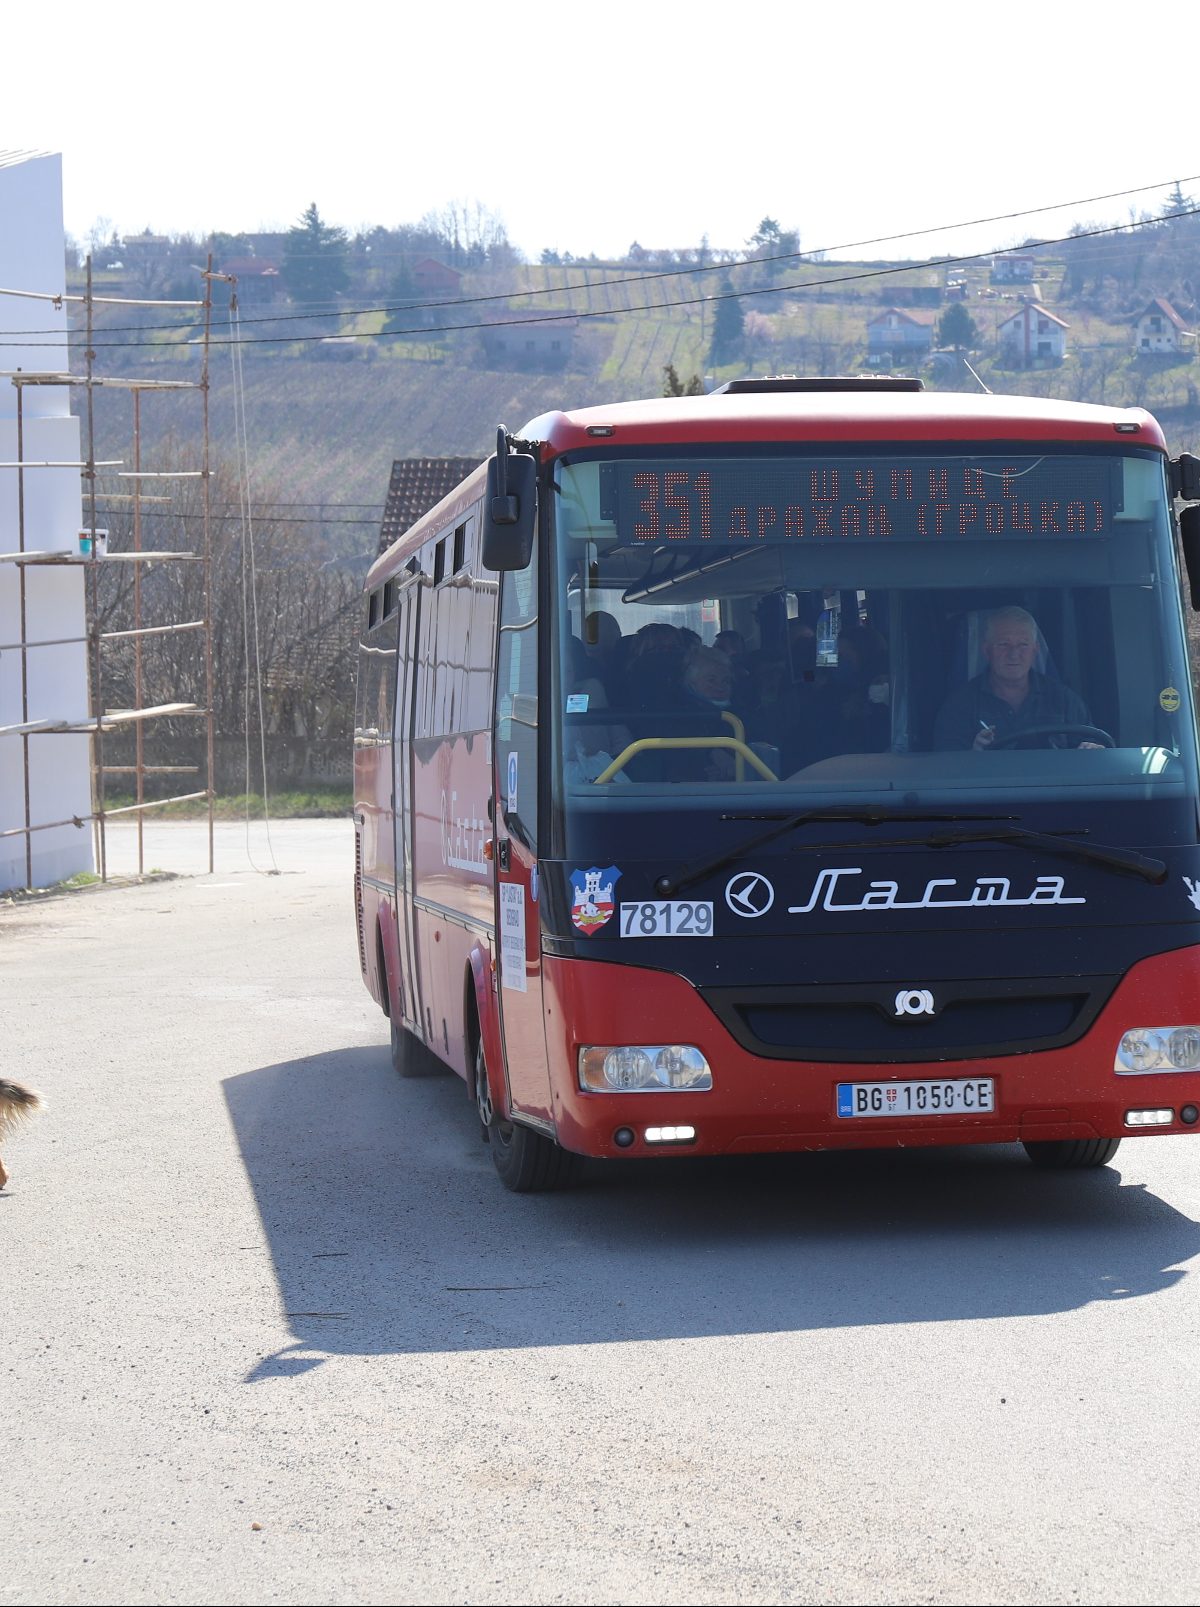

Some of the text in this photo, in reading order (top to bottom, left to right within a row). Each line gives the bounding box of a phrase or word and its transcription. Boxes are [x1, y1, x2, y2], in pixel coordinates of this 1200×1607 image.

[811, 467, 1018, 502] ШУМИЦЕ
[632, 471, 711, 540] 351
[728, 503, 893, 538] ДРАЖАЊ
[621, 902, 712, 936] 78129
[856, 1087, 882, 1112] BG
